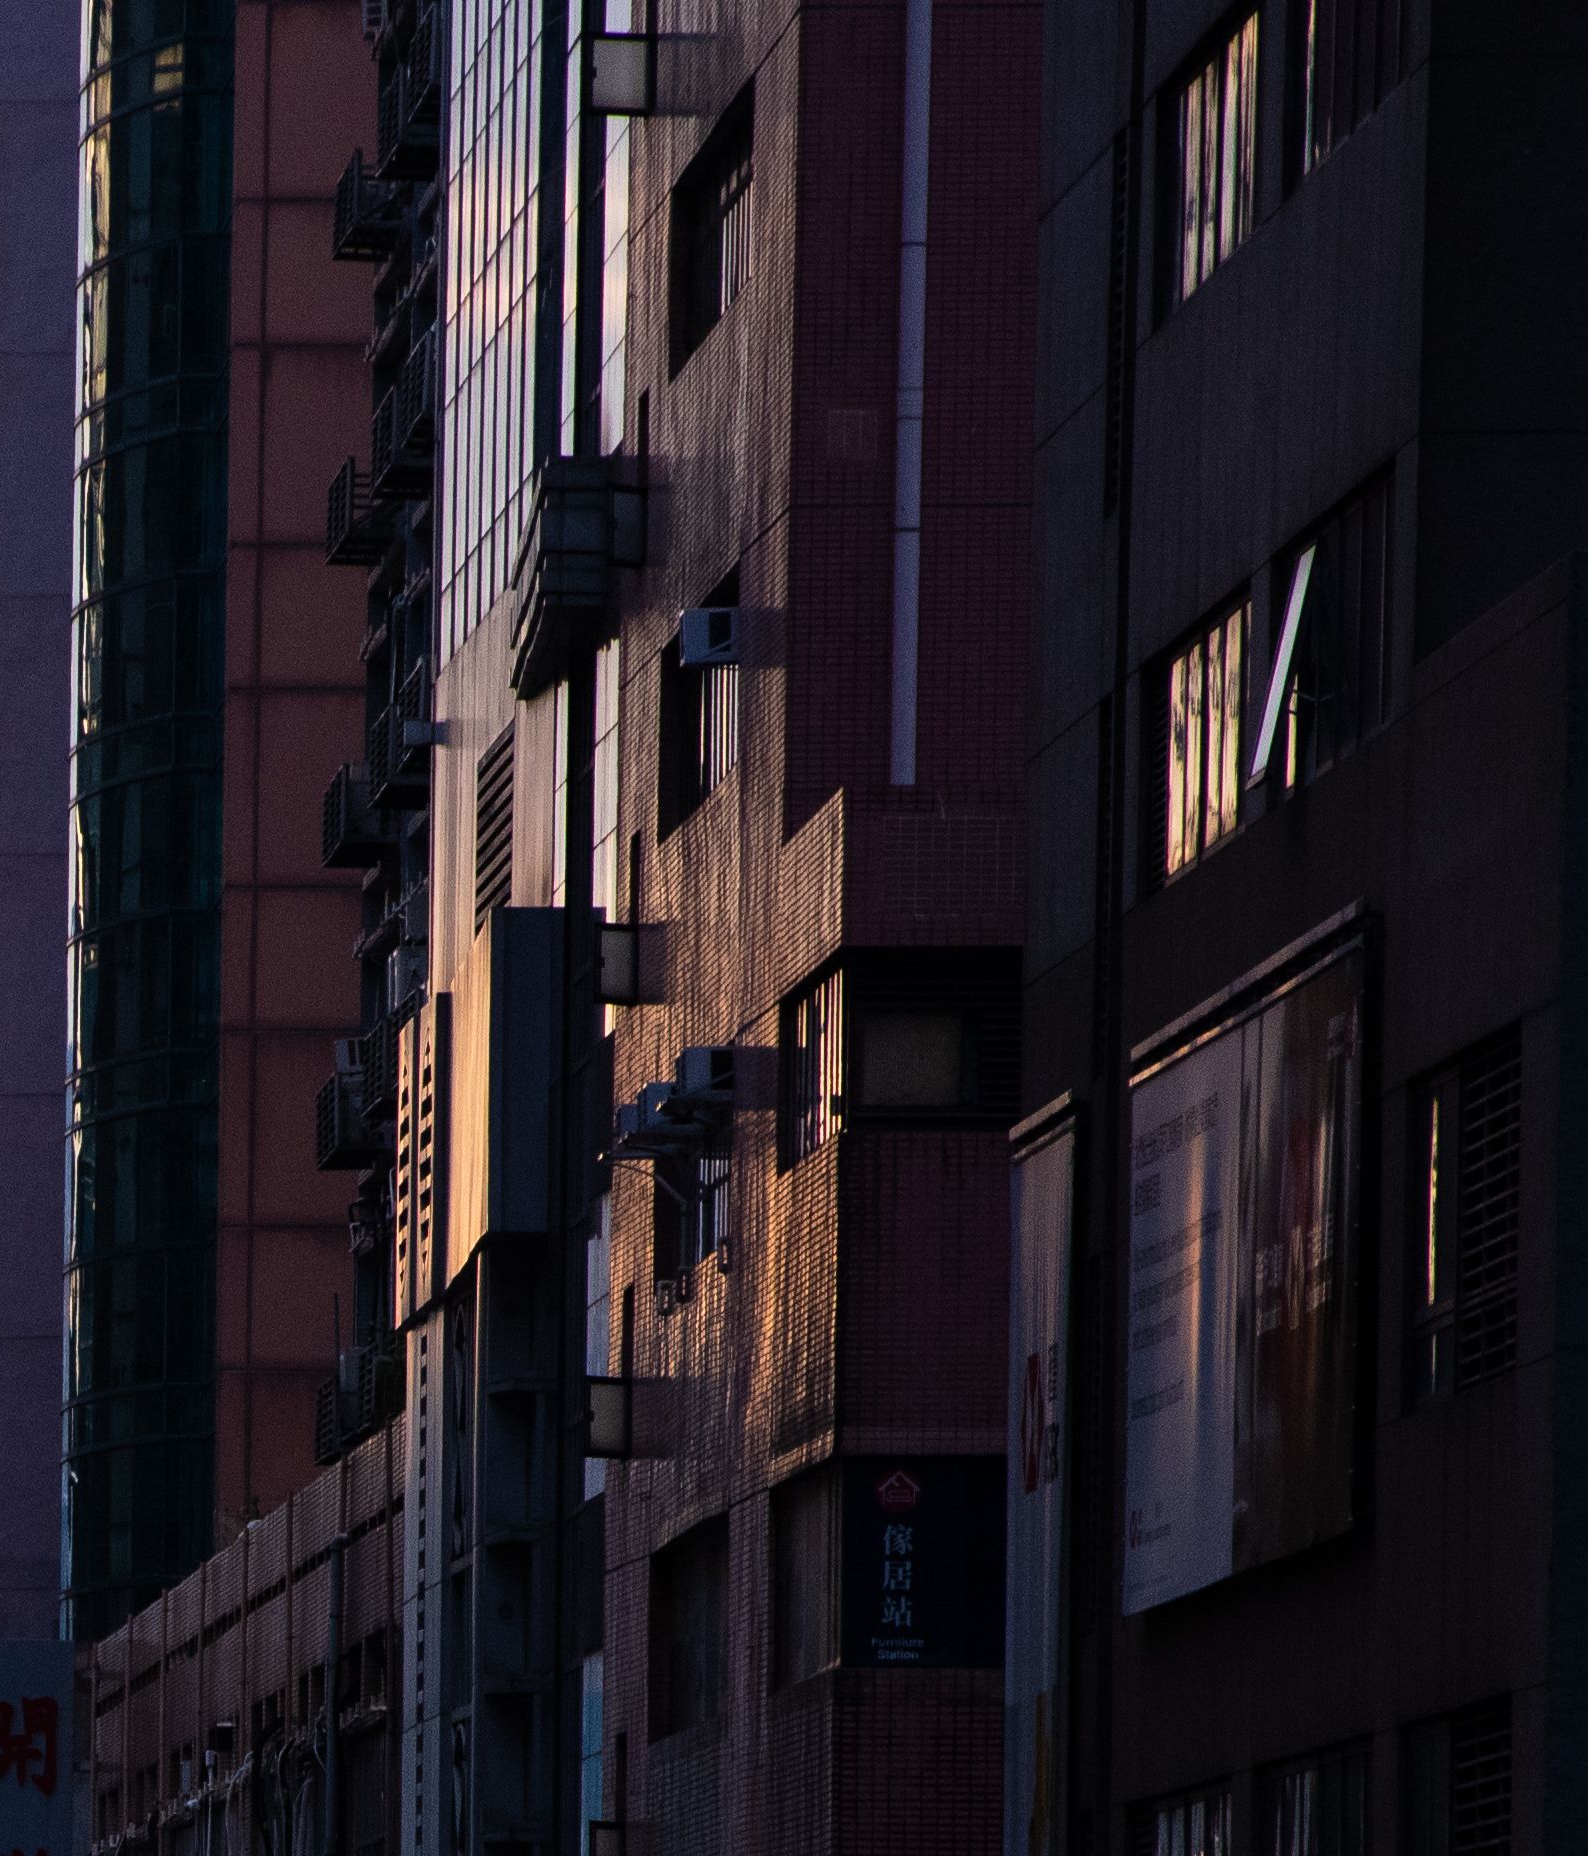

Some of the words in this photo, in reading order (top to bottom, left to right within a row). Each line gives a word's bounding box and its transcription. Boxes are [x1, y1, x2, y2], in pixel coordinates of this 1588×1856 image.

[883, 1524, 913, 1628] 傢居站
[871, 1637, 924, 1647] Furniture
[877, 1649, 919, 1660] Station
